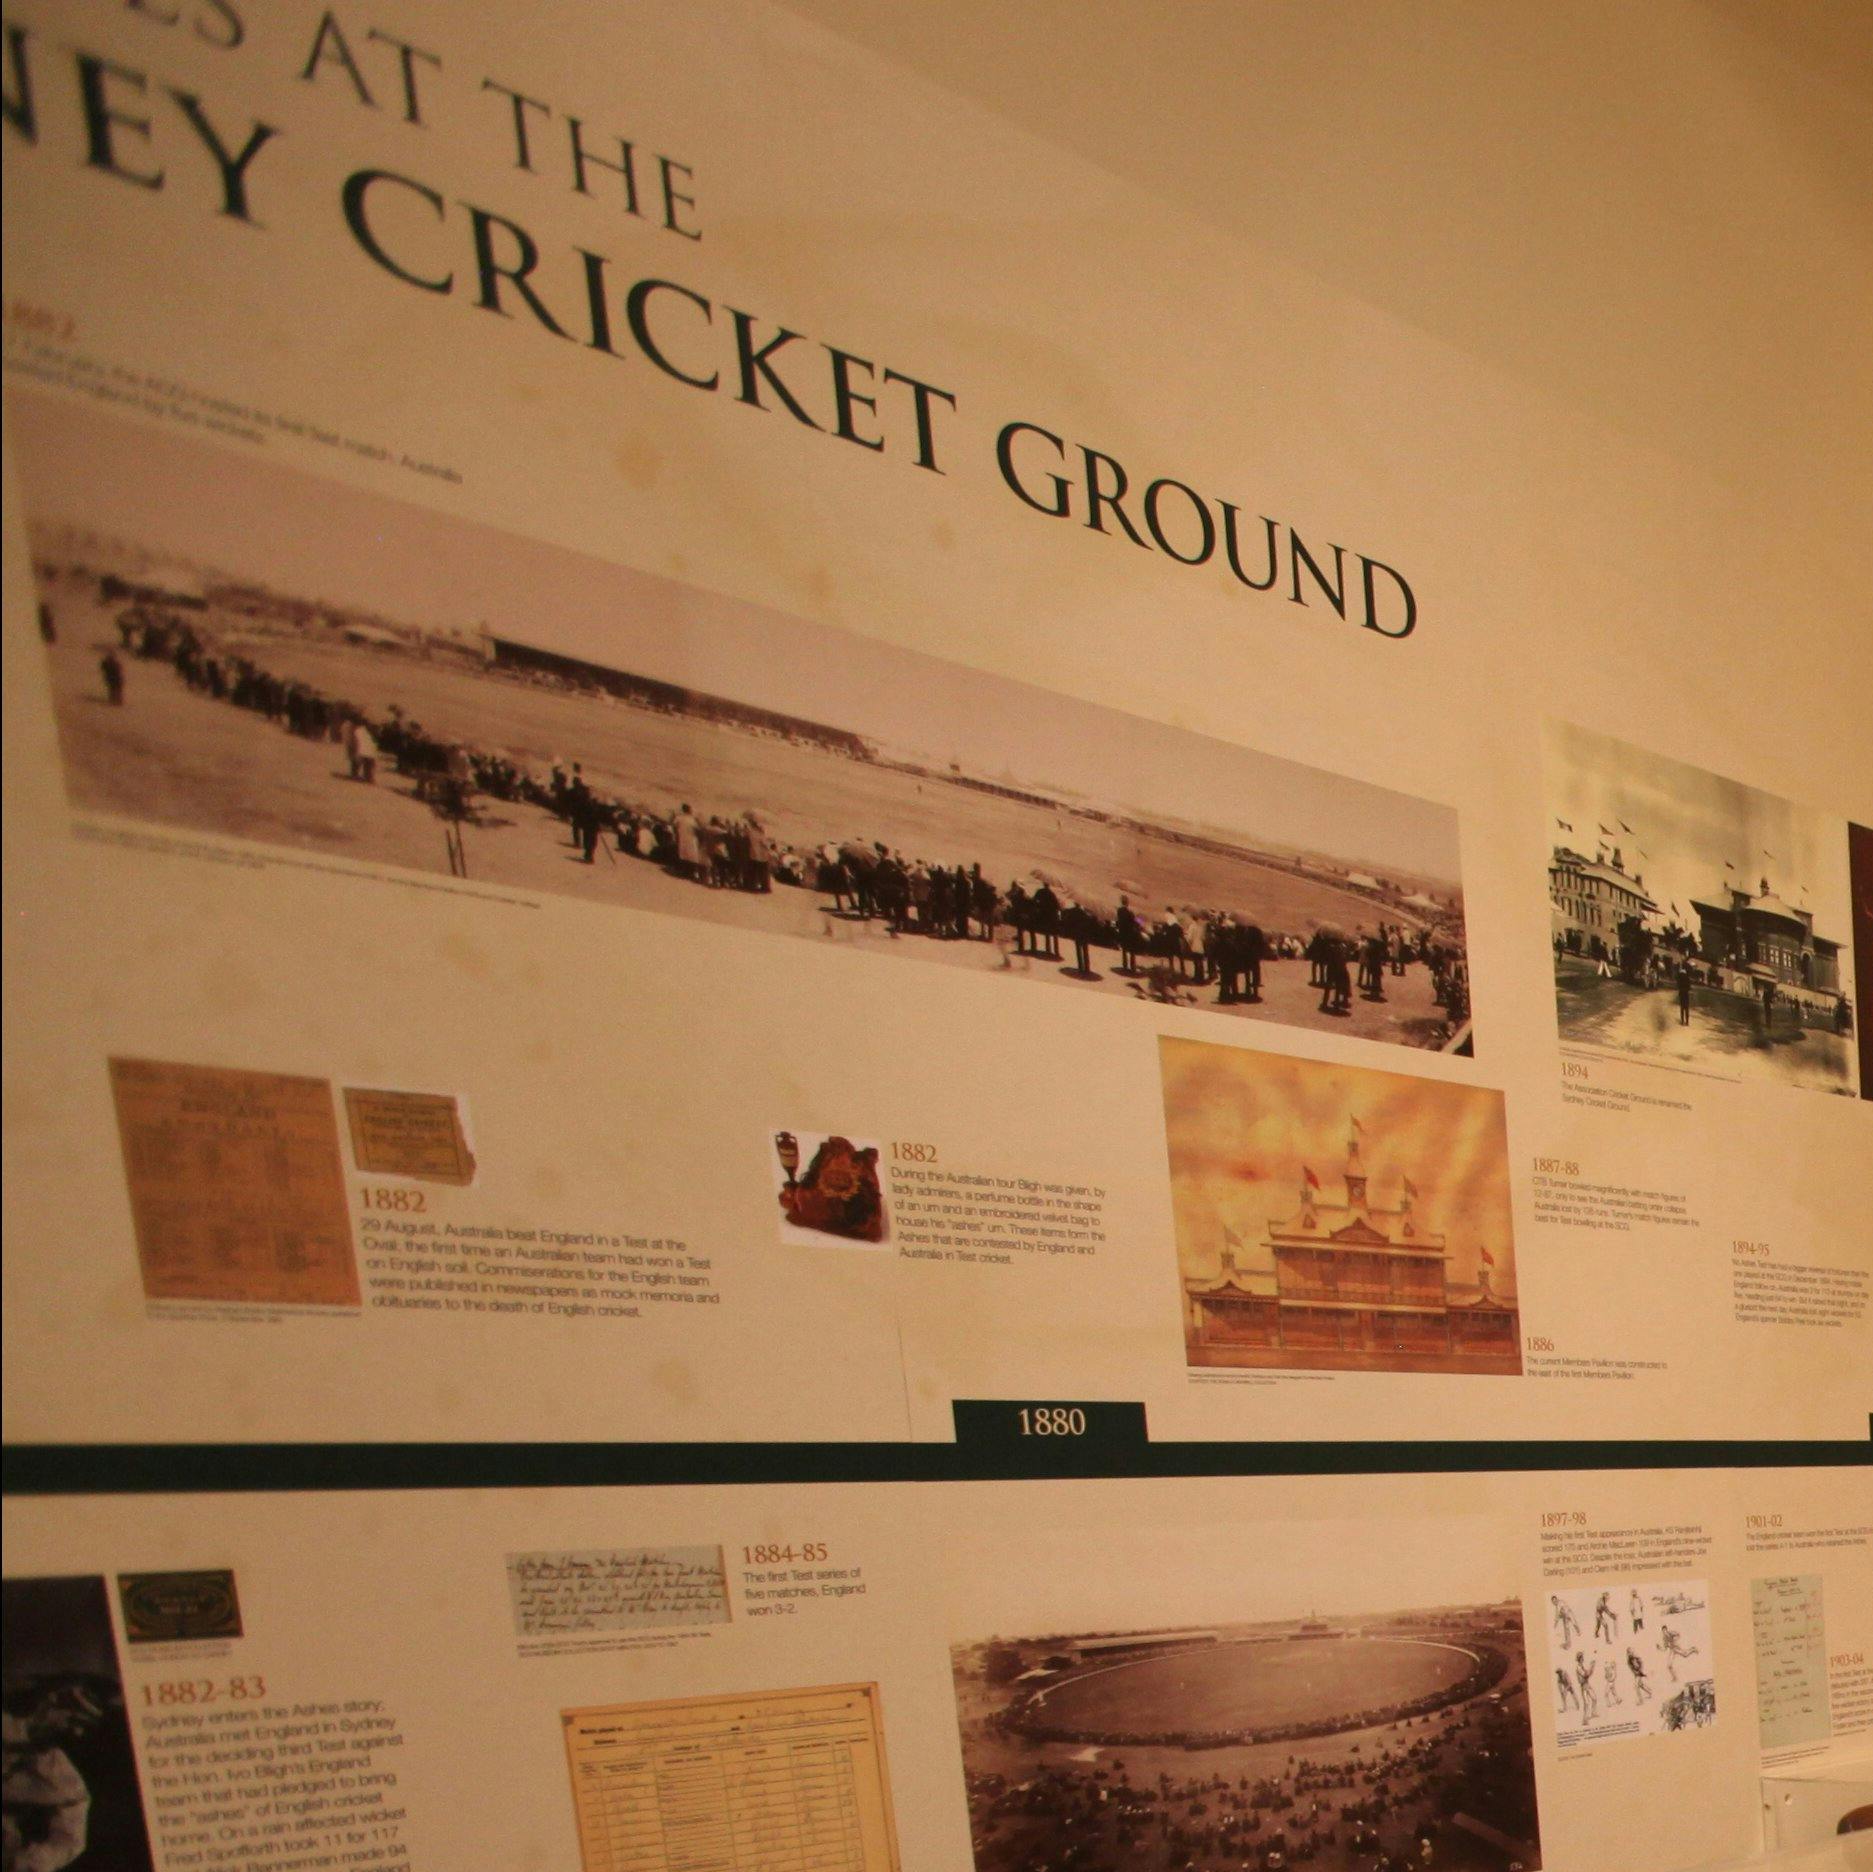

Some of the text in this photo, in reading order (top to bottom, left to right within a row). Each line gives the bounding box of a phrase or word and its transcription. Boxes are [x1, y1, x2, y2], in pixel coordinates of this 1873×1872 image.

[301, 10, 703, 242] AT THE
[341, 168, 957, 476] CRICKET
[997, 422, 1418, 640] GROUND
[1562, 1062, 1589, 1079] 1894
[891, 1141, 938, 1163] 1882
[1532, 1157, 1580, 1176] 1887-88
[359, 1187, 427, 1214] 1882
[1732, 1240, 1770, 1256] 1894-95
[1526, 1337, 1554, 1352] 1886
[1018, 1408, 1086, 1438] 1880
[1541, 1512, 1586, 1527] 1897-98
[1746, 1515, 1783, 1528] 1901-02
[742, 1542, 828, 1565] 1884-85
[743, 1567, 862, 1584] The first Test series of
[744, 1587, 764, 1600] five
[822, 1582, 866, 1597] England
[747, 1605, 772, 1616] won
[1830, 1654, 1864, 1668] 1903-04
[141, 1675, 267, 1707] 1882-83
